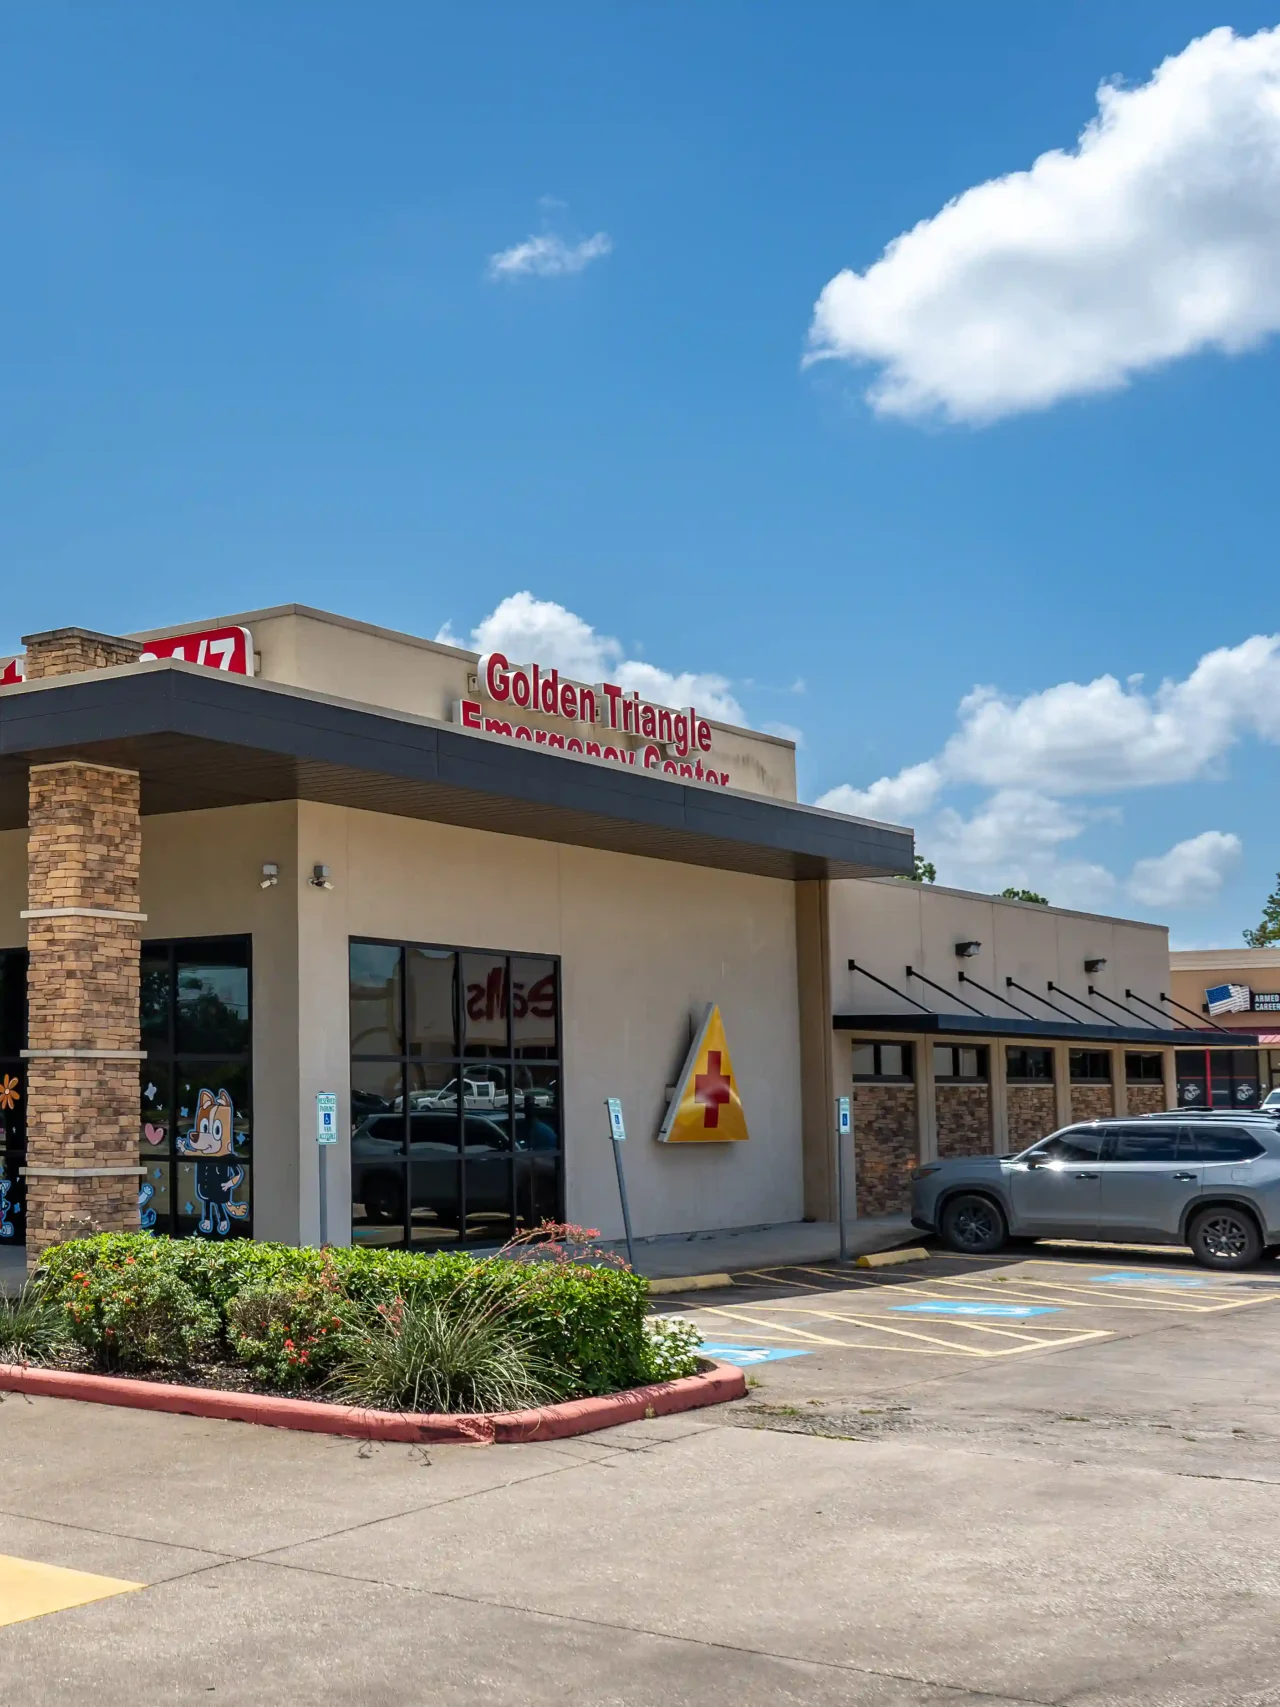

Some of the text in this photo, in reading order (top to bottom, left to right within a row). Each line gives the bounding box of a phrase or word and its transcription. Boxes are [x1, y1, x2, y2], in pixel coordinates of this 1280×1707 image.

[139, 637, 235, 672] /7
[484, 652, 712, 757] Golden Triangle
[1255, 994, 1279, 1002] ARMED
